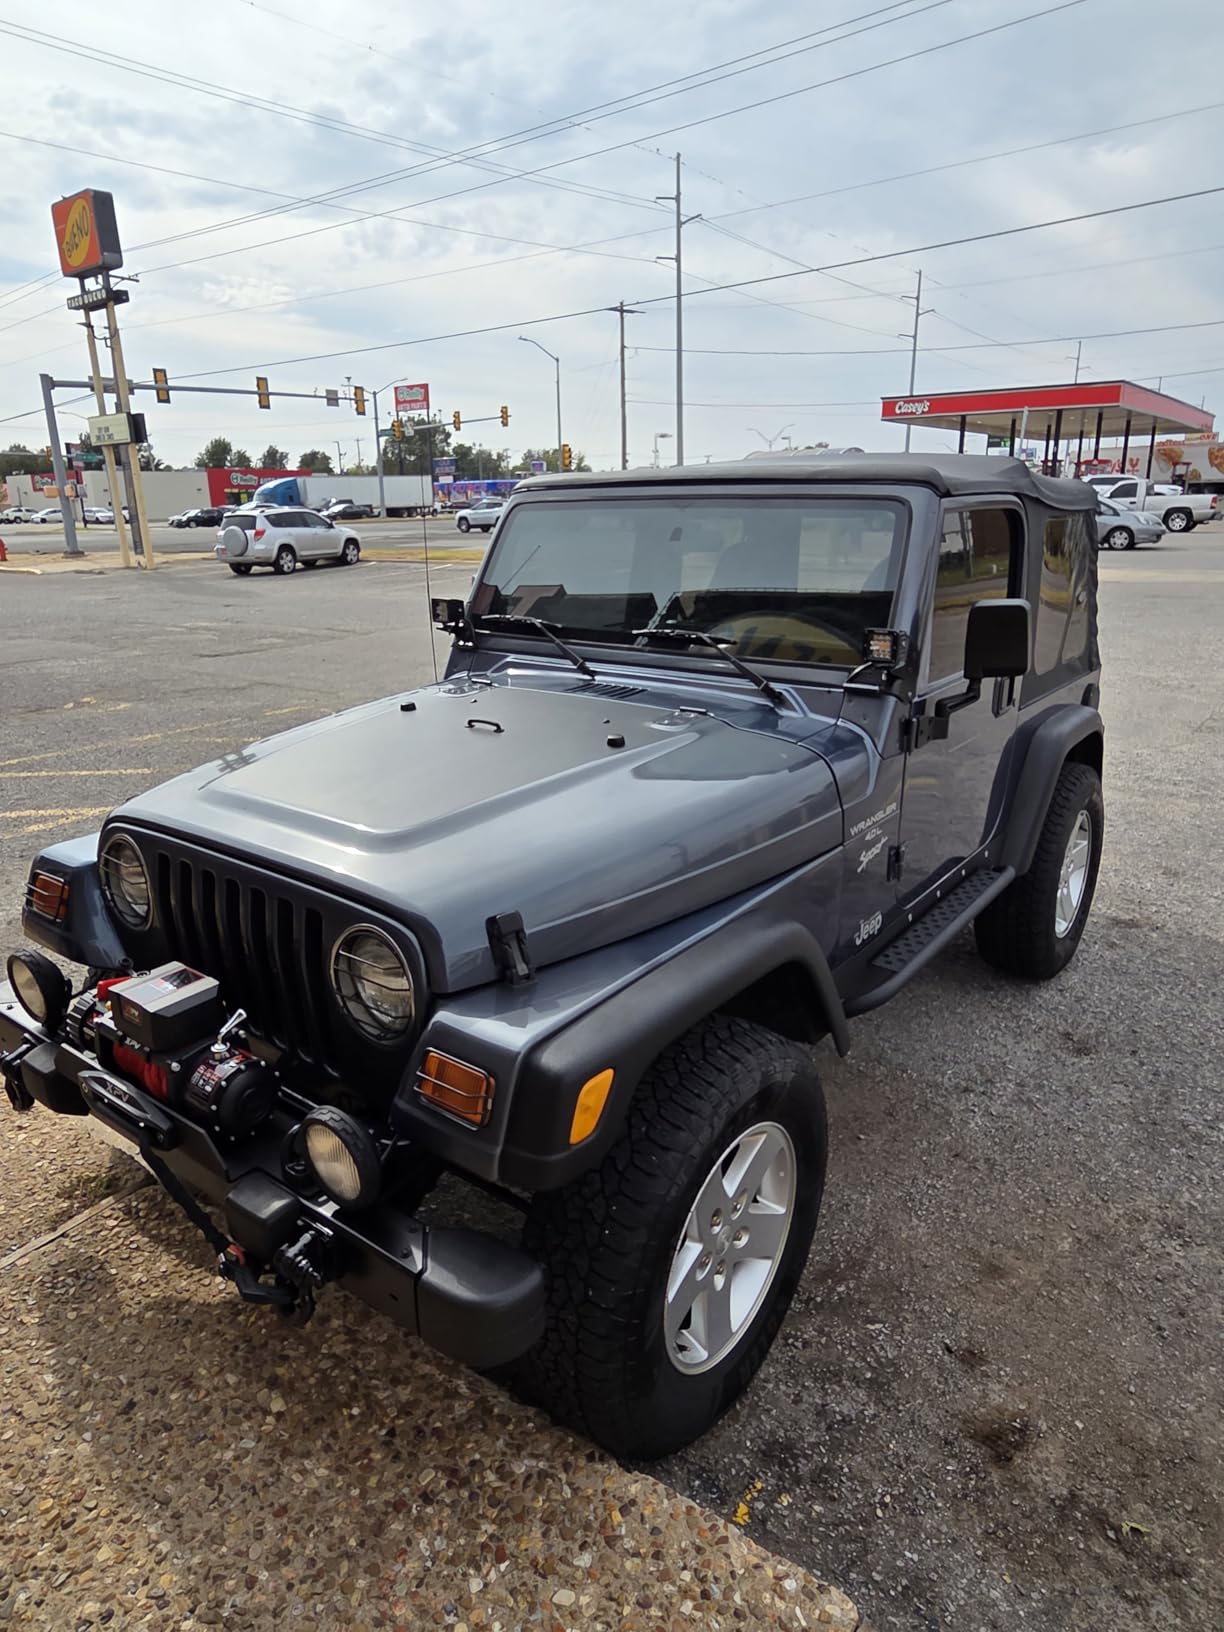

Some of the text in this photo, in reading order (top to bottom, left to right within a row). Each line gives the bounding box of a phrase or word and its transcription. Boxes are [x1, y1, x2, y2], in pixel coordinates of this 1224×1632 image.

[66, 205, 89, 258] BUENO
[67, 288, 107, 309] TACO BUENO
[895, 399, 931, 415] Casey's
[849, 802, 897, 836] WRANGLER
[857, 836, 888, 873] Sport
[854, 910, 882, 946] Jeep
[124, 1036, 142, 1050] XPV
[106, 1082, 129, 1102] XPV
